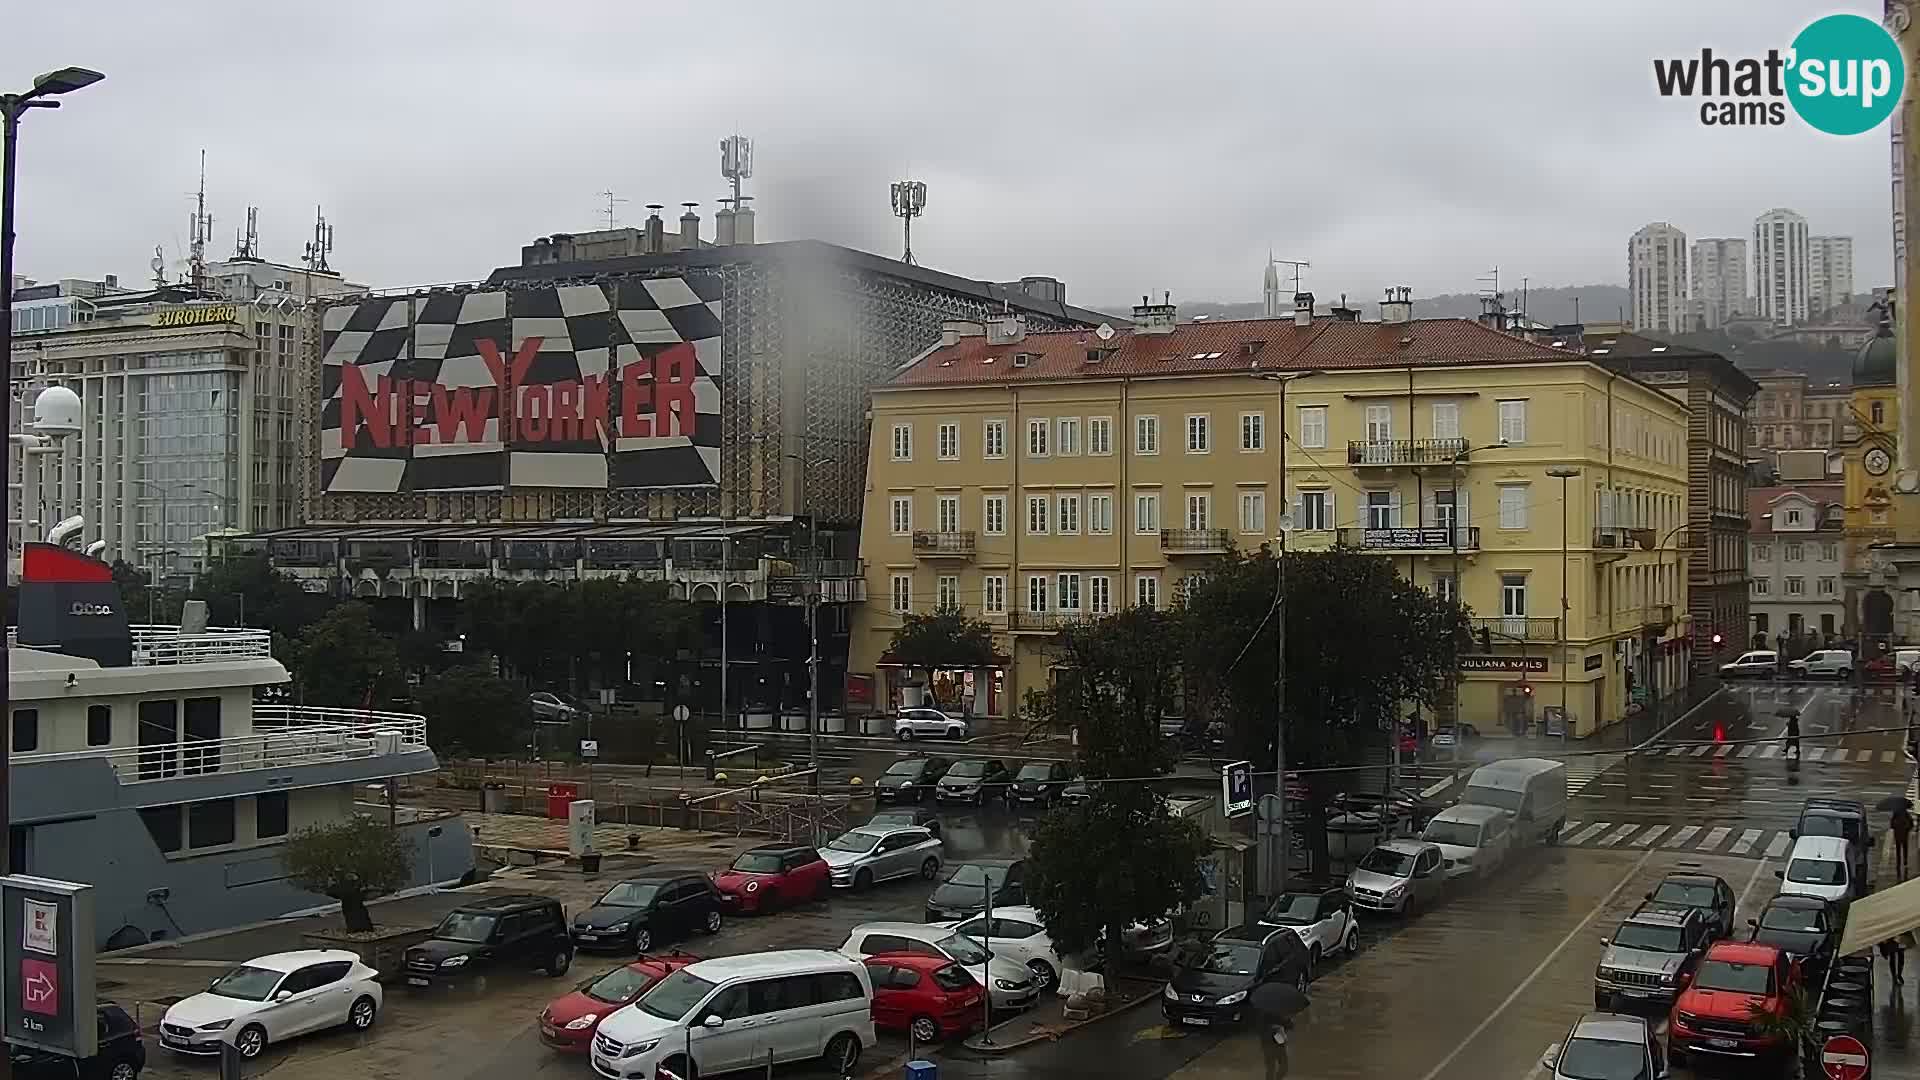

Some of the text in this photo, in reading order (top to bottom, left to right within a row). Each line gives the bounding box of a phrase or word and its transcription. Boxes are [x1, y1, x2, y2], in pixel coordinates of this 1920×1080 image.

[341, 336, 697, 449] NEW YORKER
[1461, 660, 1506, 669] JULIANA
[1234, 769, 1246, 793] P
[30, 1018, 44, 1032] km
